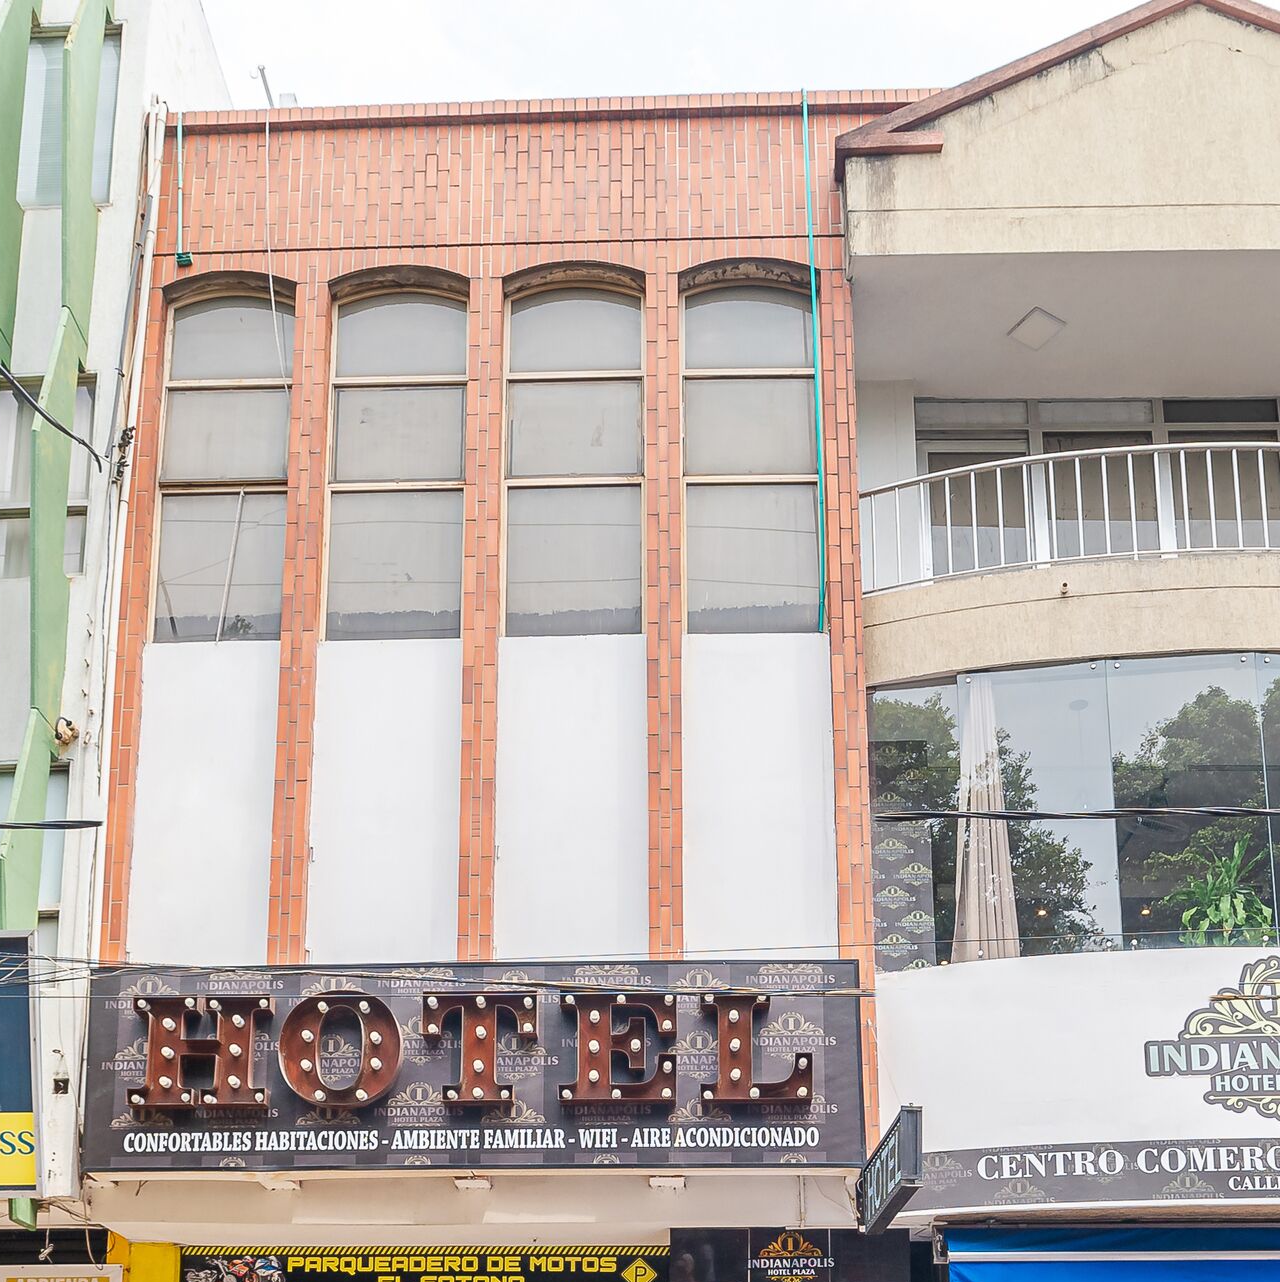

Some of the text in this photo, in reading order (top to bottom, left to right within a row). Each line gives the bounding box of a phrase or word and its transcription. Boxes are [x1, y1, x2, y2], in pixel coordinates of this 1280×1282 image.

[125, 990, 814, 1108] HOTEL
[123, 1126, 820, 1154] CONFORTABLES HABITACIONES AMBIENTE FAMILIAR WIFI AIRE ACONDICIONADO
[976, 1148, 1124, 1181] CENTRO
[286, 1255, 479, 1276] PARQUEADERO
[486, 1255, 522, 1272] DE
[528, 1255, 618, 1273] MOTOS
[747, 1257, 836, 1269] INDIANAPOLIS
[767, 1268, 816, 1276] HOTEL PLAZA
